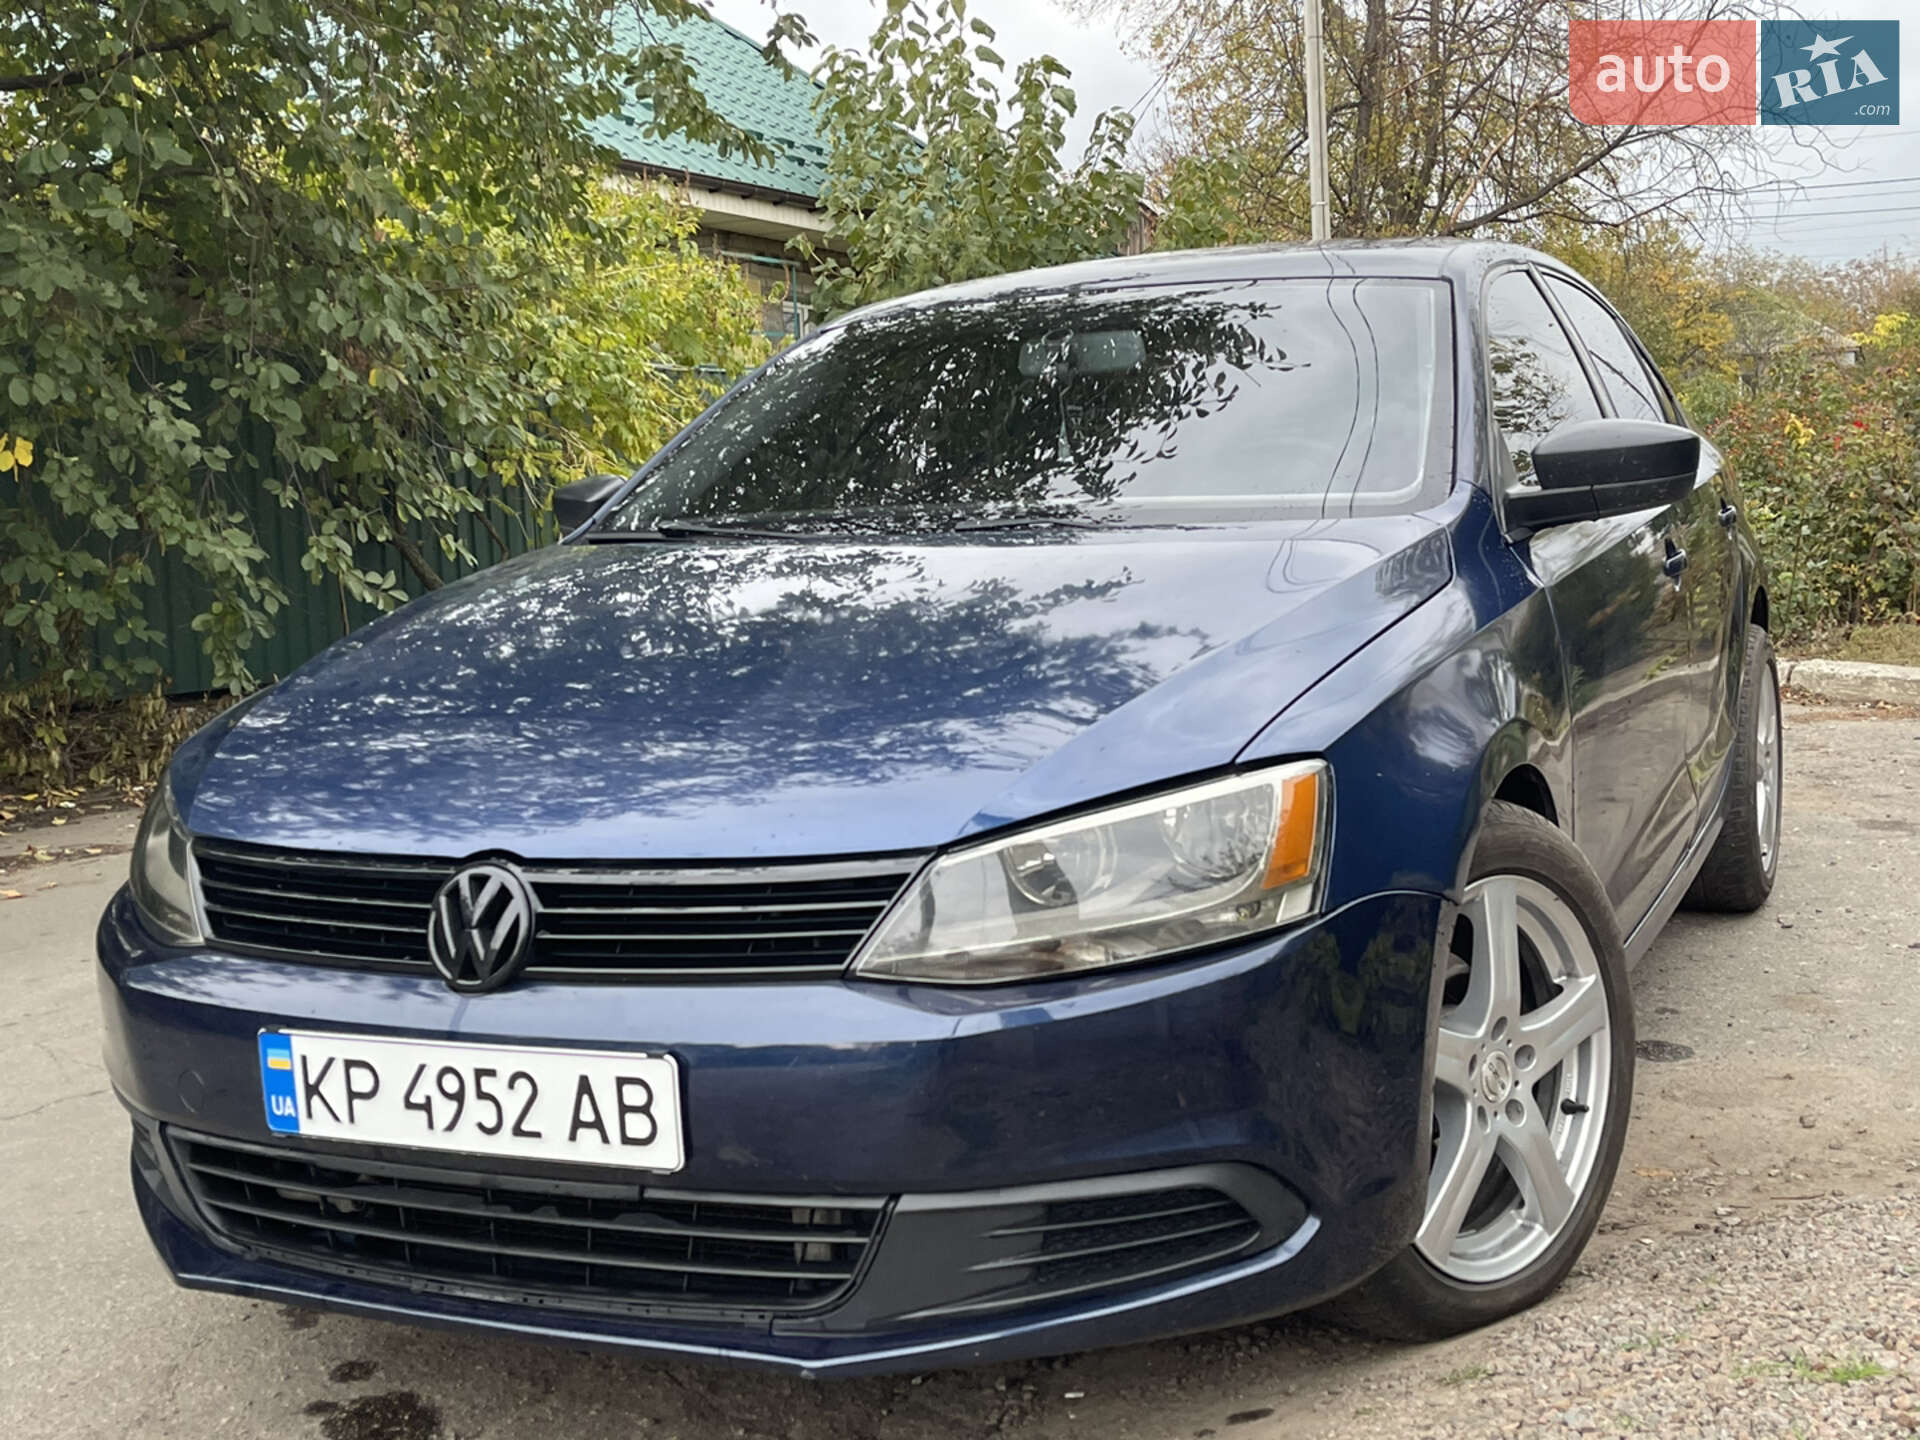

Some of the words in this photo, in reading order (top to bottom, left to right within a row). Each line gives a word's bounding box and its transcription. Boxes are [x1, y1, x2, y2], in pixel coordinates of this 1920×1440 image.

[271, 1095, 296, 1118] UA
[300, 1055, 380, 1124] KP
[404, 1063, 542, 1138] 4952
[568, 1075, 658, 1146] AB
